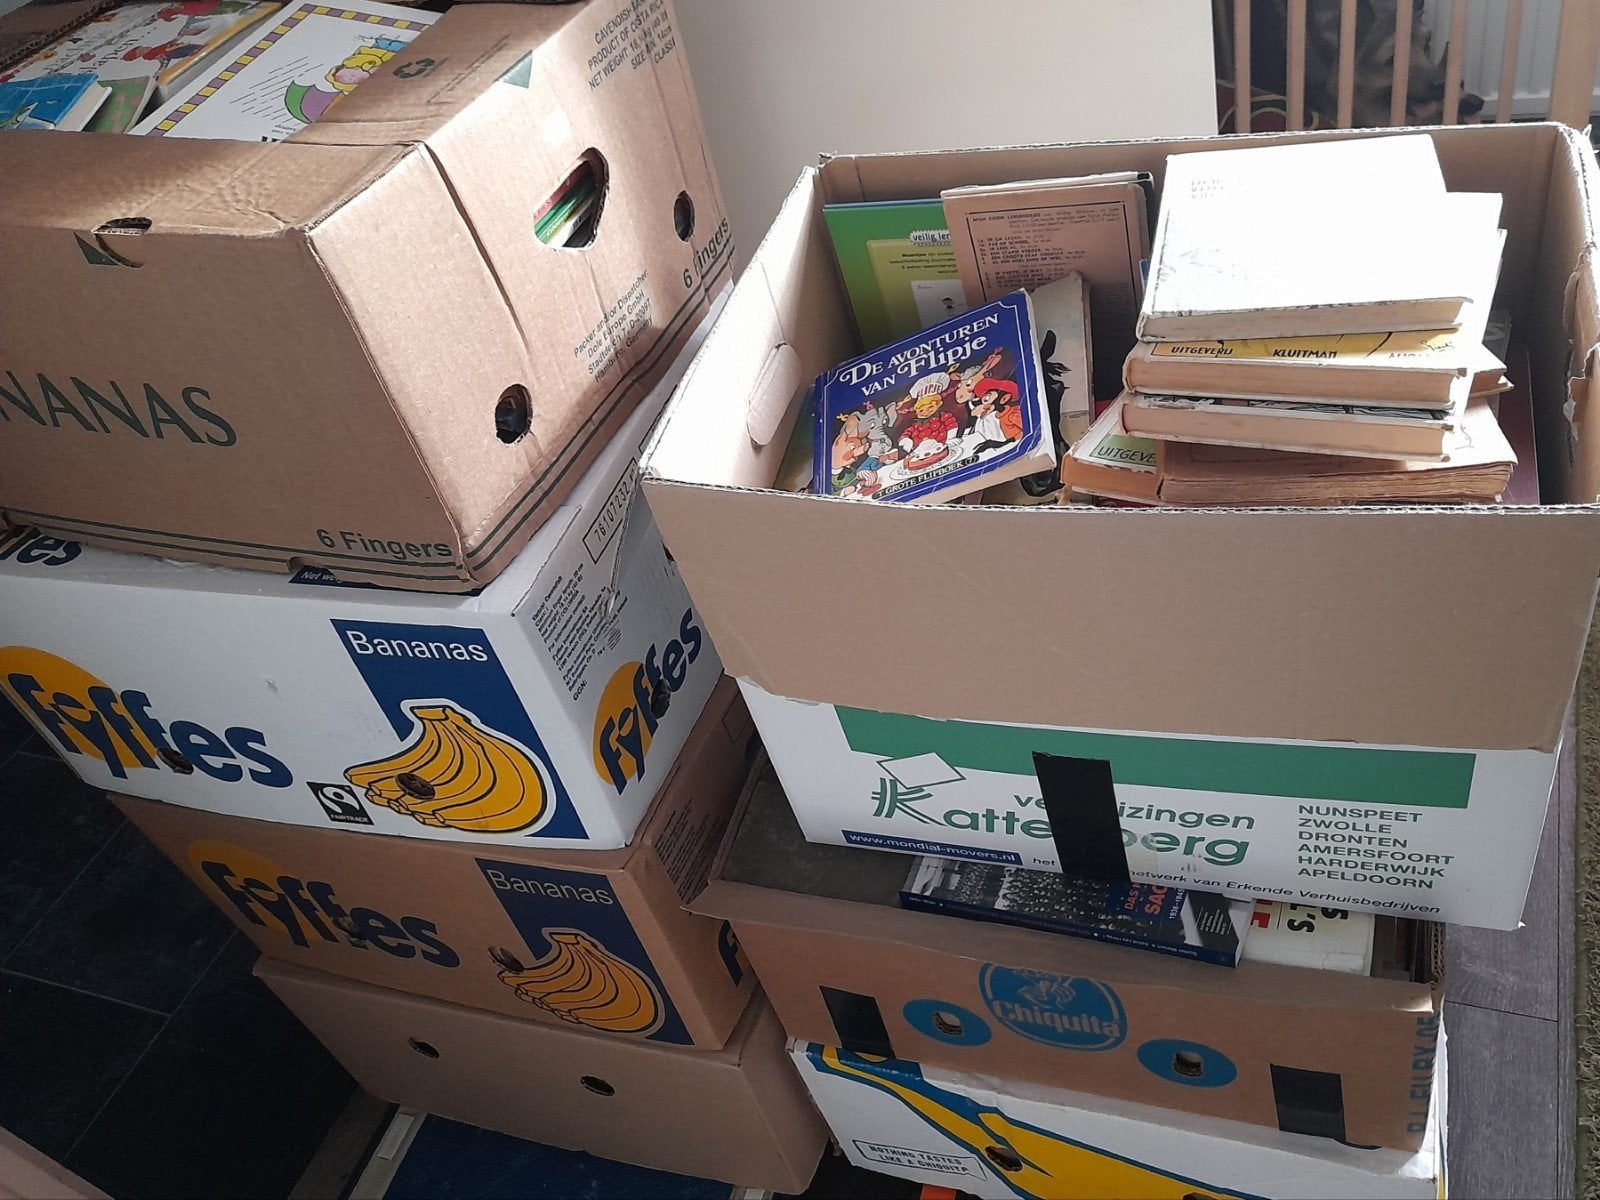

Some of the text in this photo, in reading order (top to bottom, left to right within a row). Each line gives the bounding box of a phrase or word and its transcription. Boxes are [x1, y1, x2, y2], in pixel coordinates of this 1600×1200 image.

[588, 35, 620, 71] PRODUCT
[620, 26, 628, 42] OF
[630, 50, 646, 70] SIZE
[588, 71, 603, 91] NET
[912, 232, 938, 242] veilig
[684, 268, 692, 288] 6
[573, 327, 597, 358] Packer
[587, 338, 602, 358] Dole
[603, 312, 627, 341] Europe
[888, 313, 999, 367] AVONTUREN
[588, 335, 622, 375] Stadtdech
[861, 336, 988, 397] VAN Flipje
[1170, 346, 1338, 359] UITGEVERIJ KLUITMAN
[917, 383, 941, 398] FLIPJE
[0, 369, 237, 448] NANAS
[886, 477, 917, 494] GROTE
[918, 462, 964, 481] FLIPBOEK
[316, 528, 452, 560] 6 Fingers
[300, 571, 322, 580] Net
[345, 628, 488, 663] Bananas
[599, 607, 702, 797] Fyffes
[7, 672, 294, 788] Fyffes
[871, 777, 1250, 867] Katteerg
[1014, 794, 1256, 830] veizingen
[1298, 804, 1423, 822] NUNSPEET
[1298, 818, 1392, 834] ZWOLLE
[849, 832, 1016, 863] www.mondial-movers.nl
[1297, 843, 1455, 866] AMERSFOORT
[1298, 830, 1408, 848] DRONTEN
[1298, 855, 1446, 878] HARDERWIJK
[1298, 868, 1434, 890] APELDOORN
[486, 868, 614, 906] Bananas
[1032, 856, 1056, 867] het
[1192, 878, 1221, 888] van
[1226, 881, 1294, 896] Erkende
[1298, 889, 1441, 915] Verhuisbedrijven
[1124, 890, 1139, 910] DAS
[202, 859, 460, 968] Fyffes
[992, 1000, 1120, 1038] Chiquita
[868, 1145, 962, 1165] NOTHING TASTES
[879, 1154, 901, 1164] LIKE
